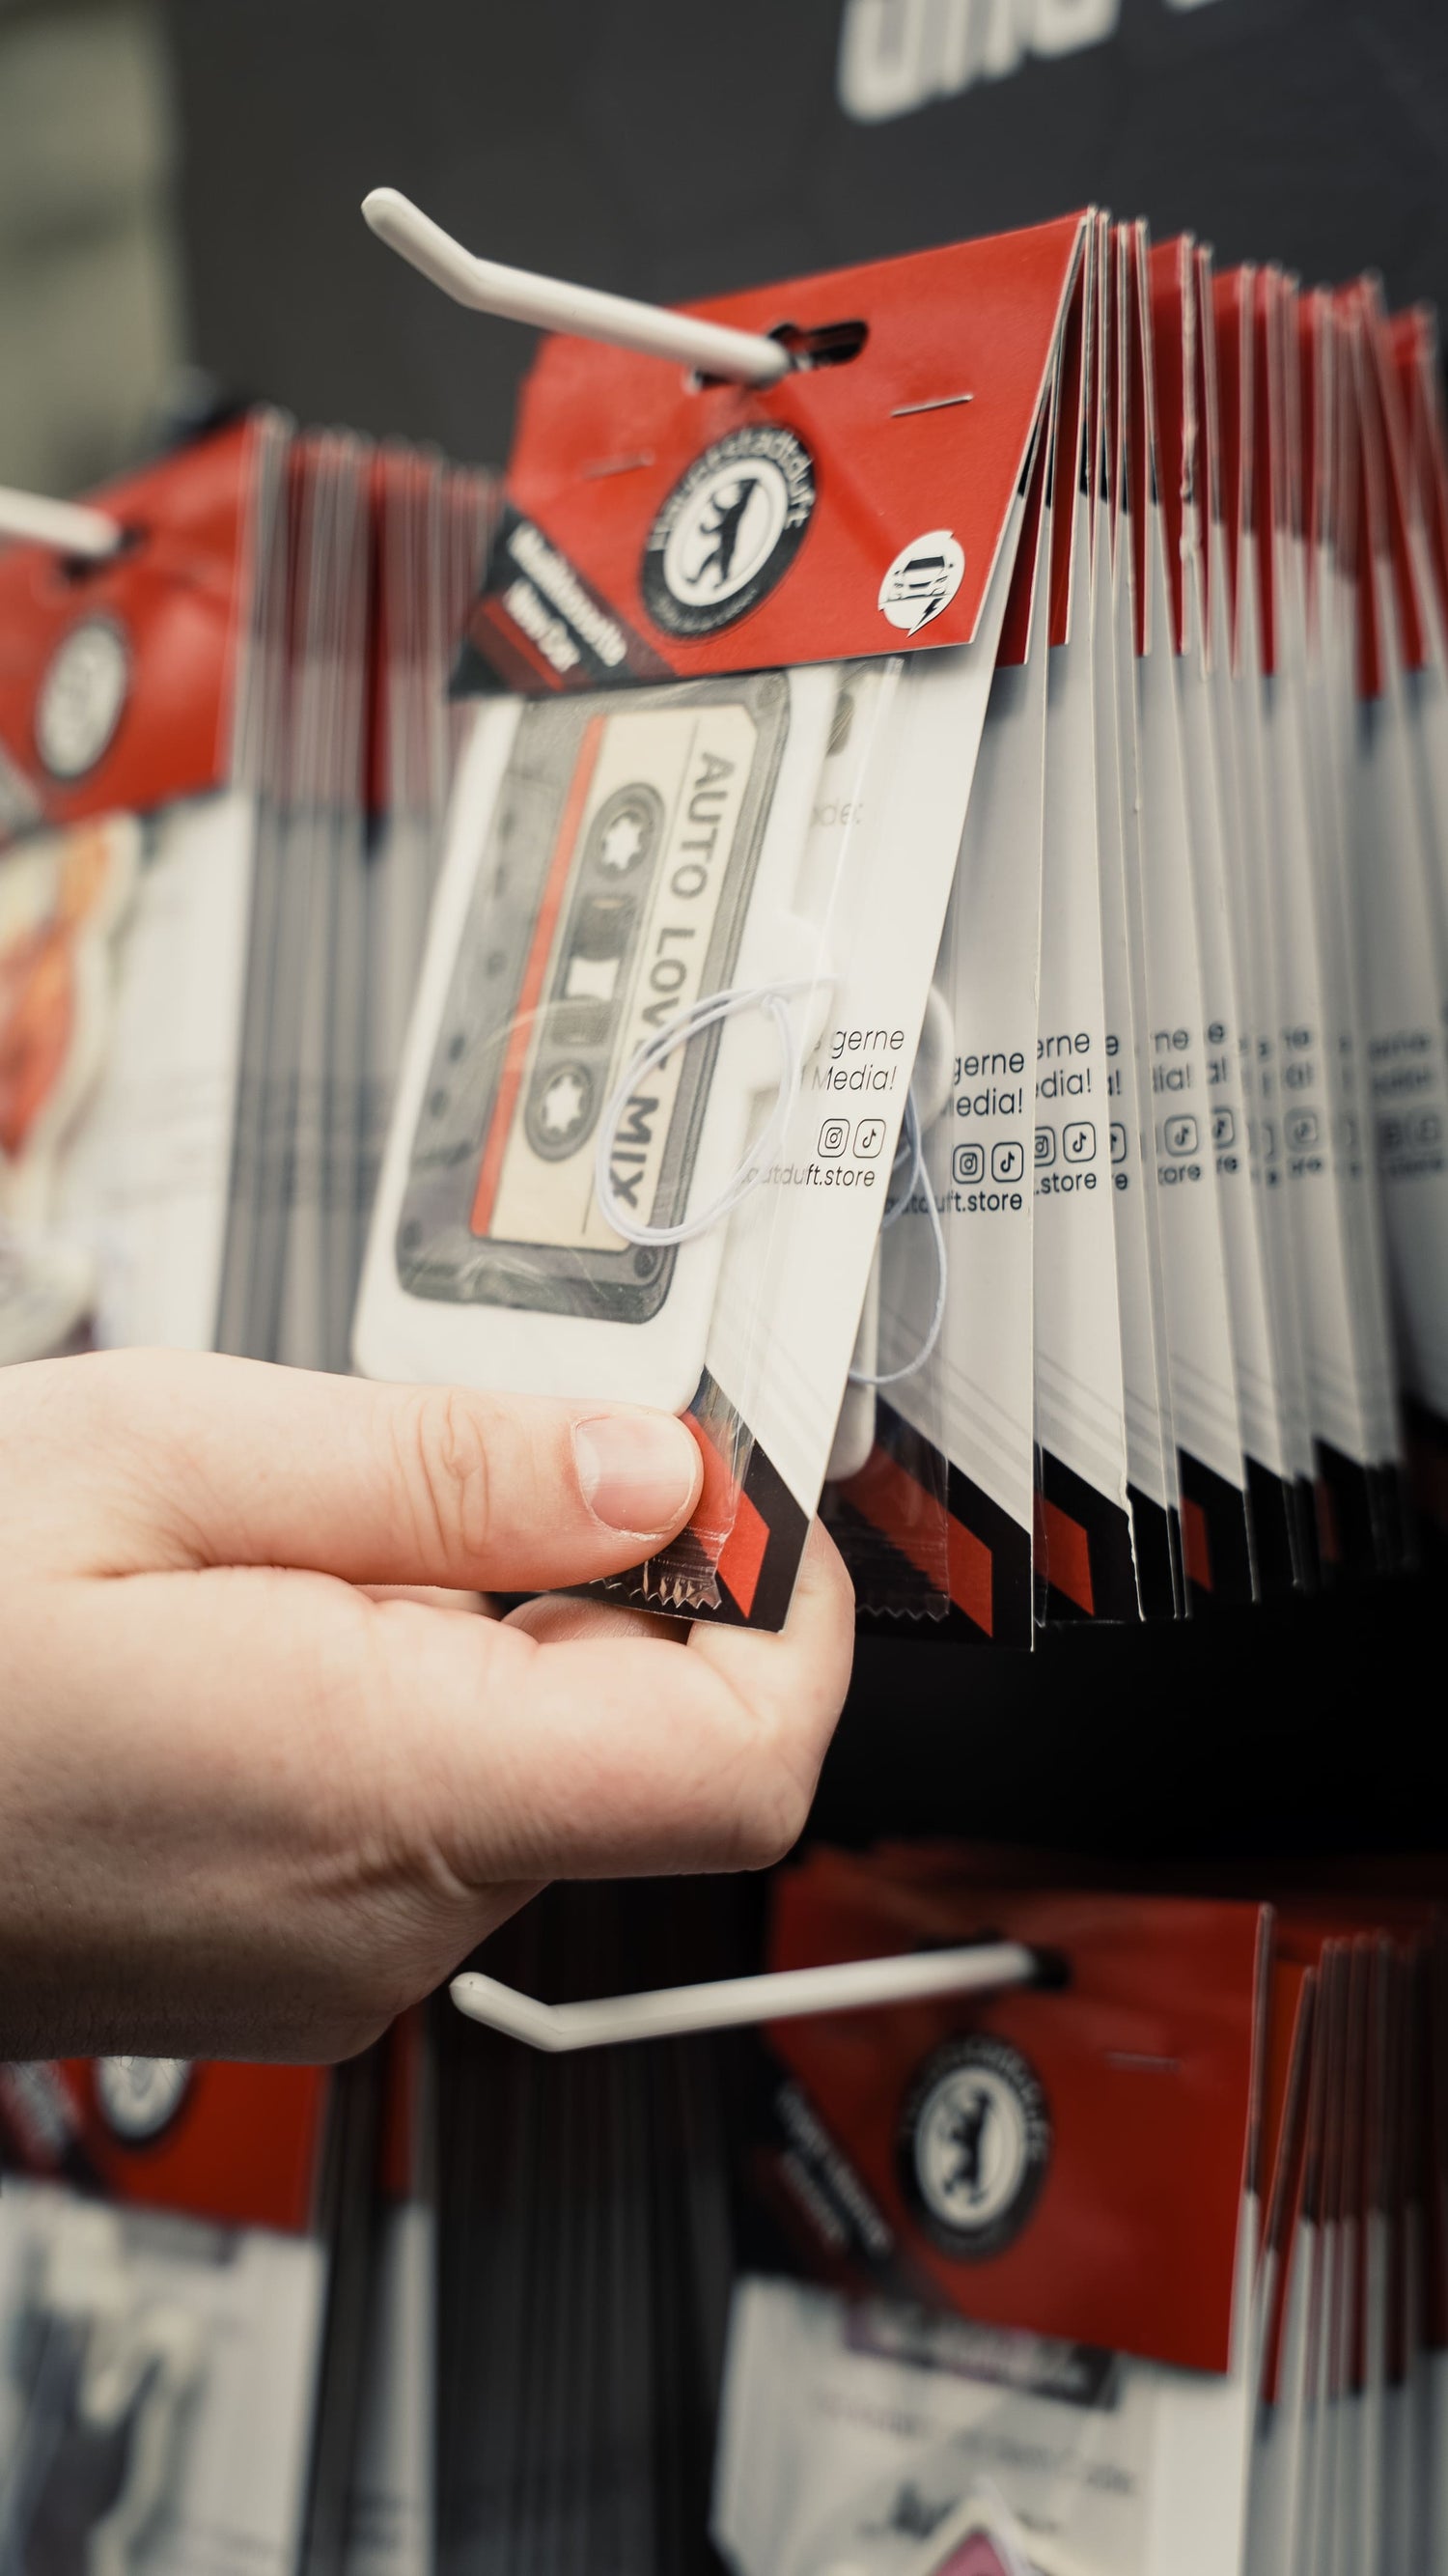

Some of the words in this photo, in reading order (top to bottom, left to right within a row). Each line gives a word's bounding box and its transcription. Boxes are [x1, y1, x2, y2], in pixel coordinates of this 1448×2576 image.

[670, 750, 736, 900] AUTO
[830, 1030, 905, 1059] gerne
[812, 1064, 897, 1090] Media!
[1035, 1068, 1092, 1100] dia!
[944, 1087, 1022, 1117] edia!
[610, 1094, 660, 1211] MIX
